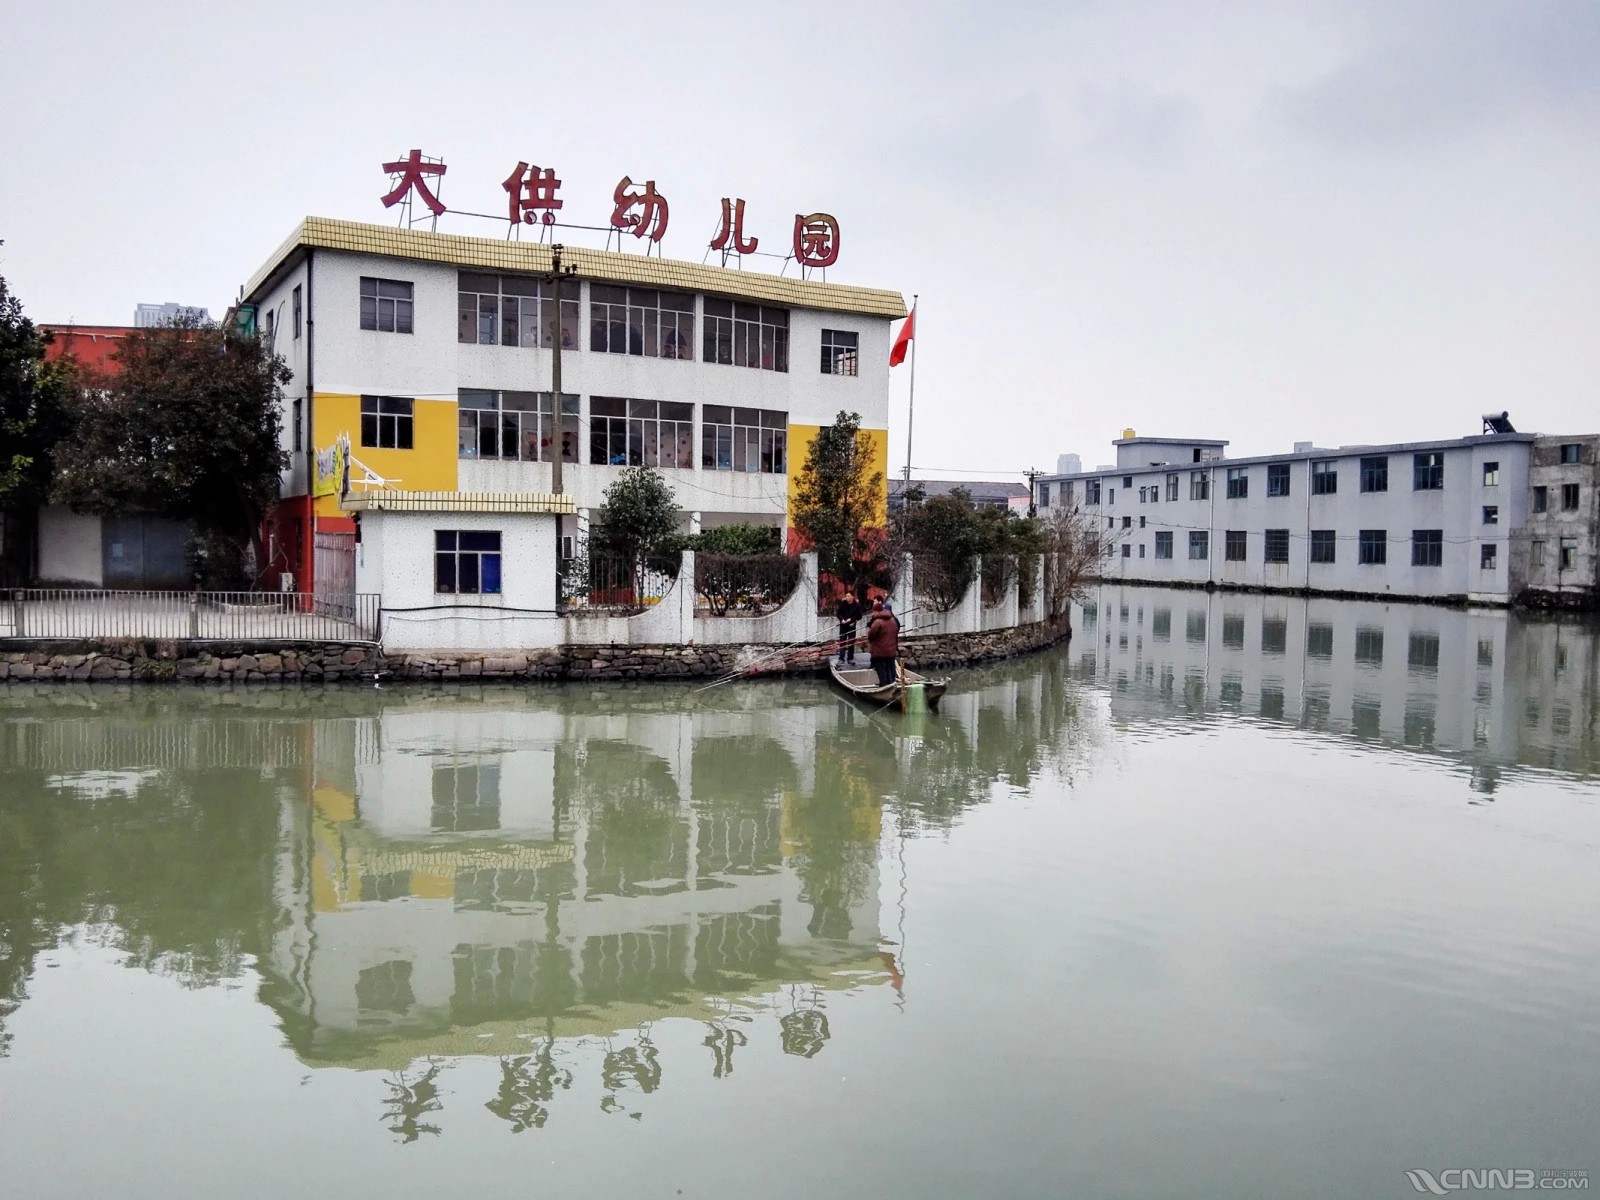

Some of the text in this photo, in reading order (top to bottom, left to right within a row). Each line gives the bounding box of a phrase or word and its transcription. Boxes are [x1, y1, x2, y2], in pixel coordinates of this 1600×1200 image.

[381, 149, 840, 267] 大供幼儿园
